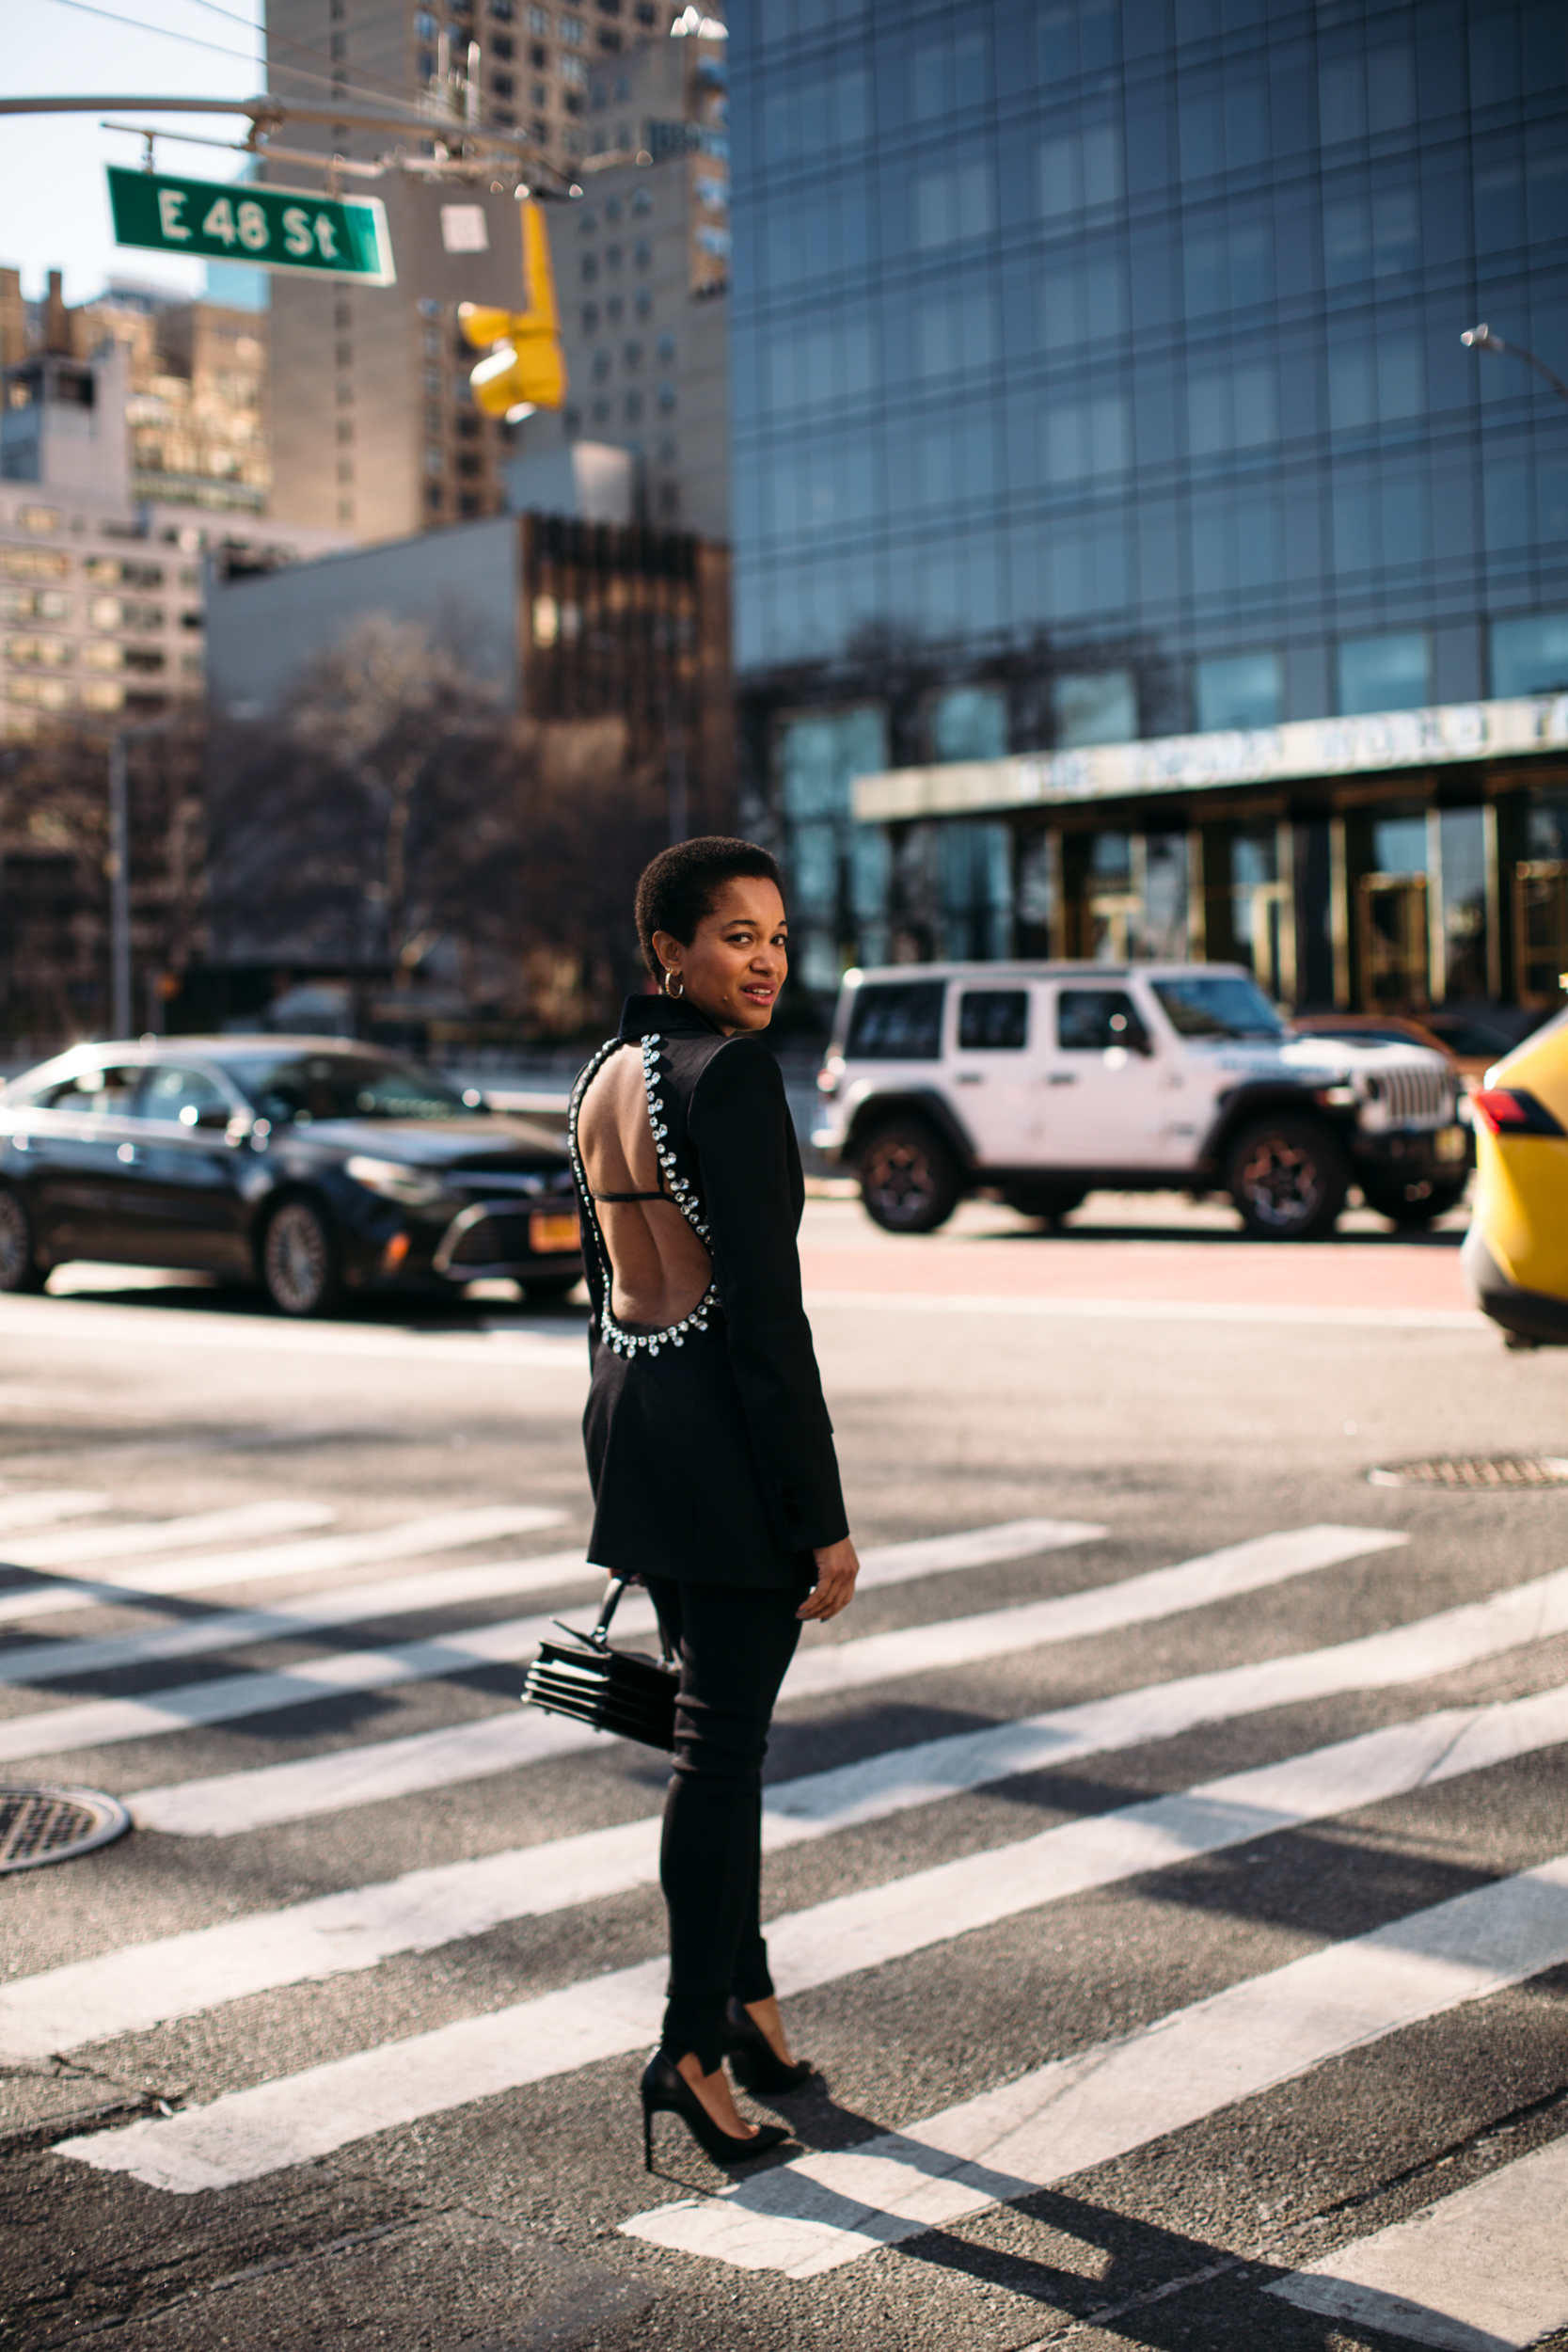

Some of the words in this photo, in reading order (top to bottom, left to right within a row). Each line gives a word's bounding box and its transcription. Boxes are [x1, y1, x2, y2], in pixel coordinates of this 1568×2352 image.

[158, 187, 193, 242] E
[202, 196, 270, 249] 48
[282, 206, 340, 261] St
